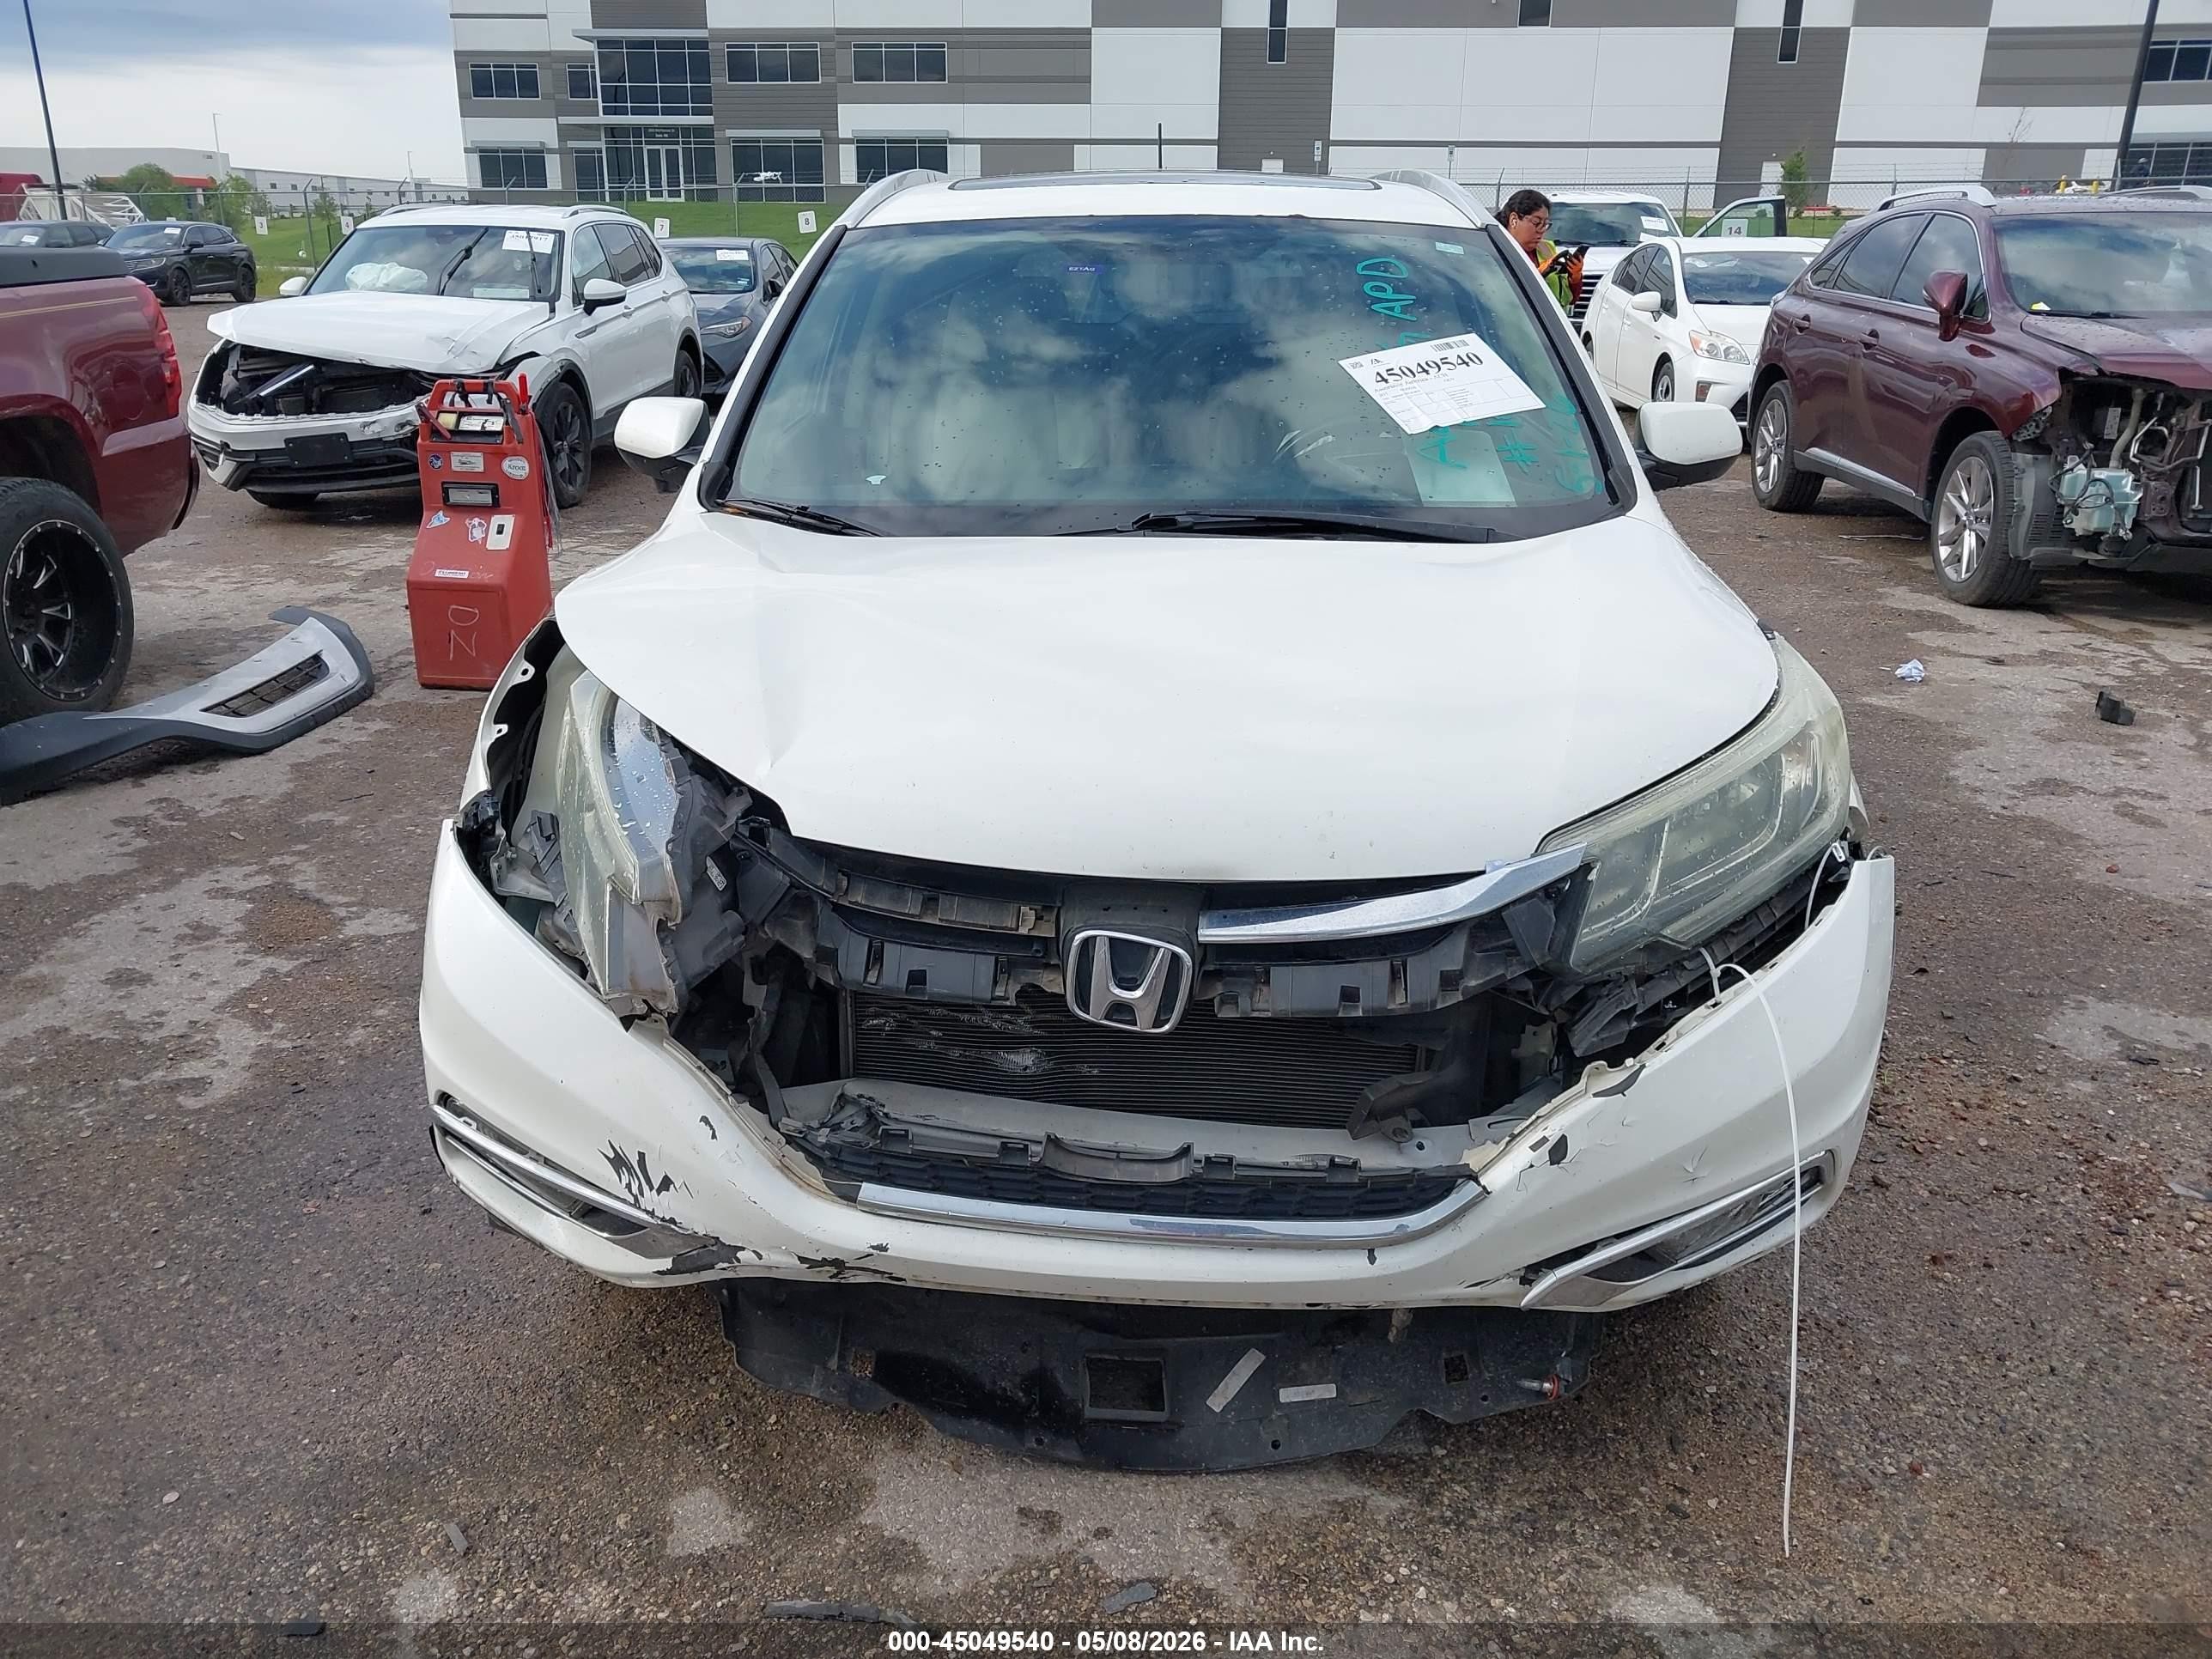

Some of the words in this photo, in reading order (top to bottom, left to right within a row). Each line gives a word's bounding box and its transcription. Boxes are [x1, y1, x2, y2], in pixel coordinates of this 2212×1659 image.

[1727, 226, 1742, 235] 14
[1356, 258, 1418, 321] APD
[1375, 351, 1484, 384] 45049540
